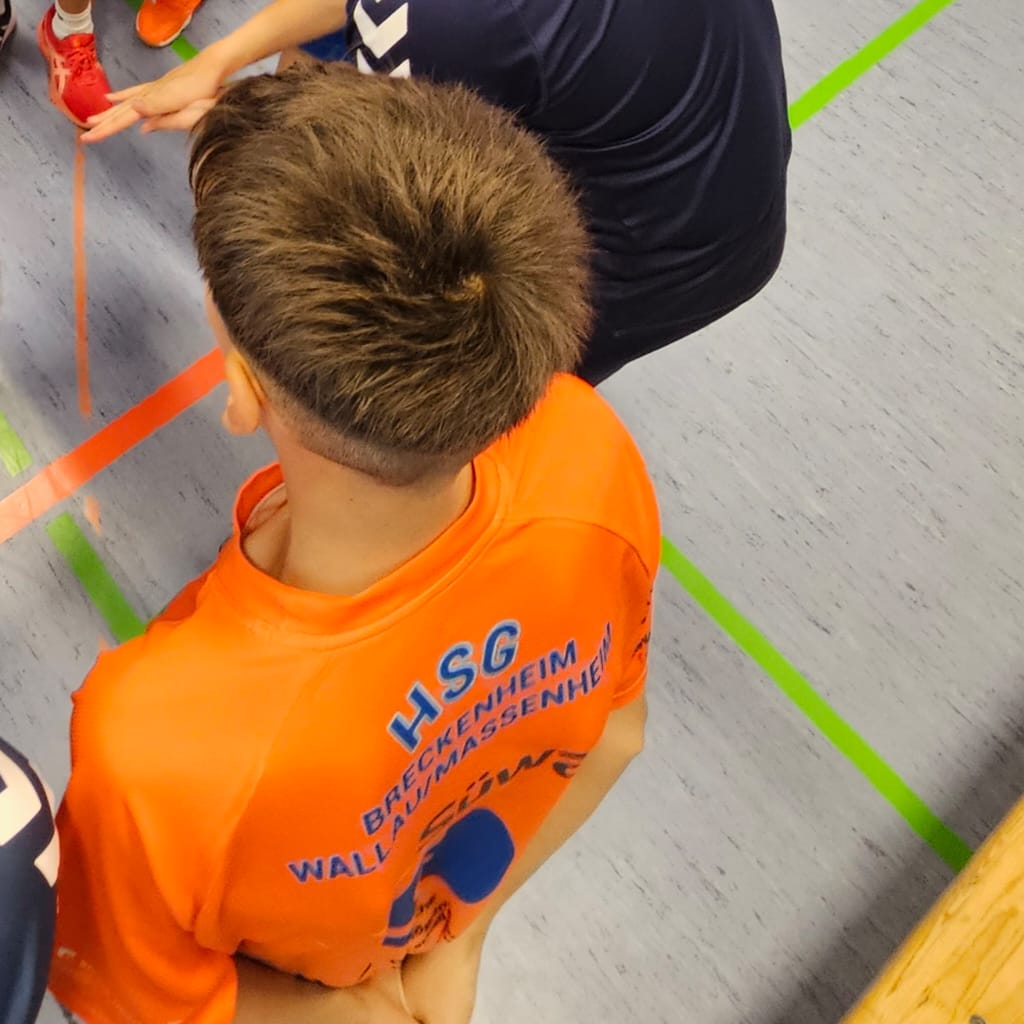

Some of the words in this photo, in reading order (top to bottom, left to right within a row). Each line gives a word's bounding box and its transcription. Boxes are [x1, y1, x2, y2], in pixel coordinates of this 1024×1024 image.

[288, 621, 613, 883] WALLAU/MASSENHEIM
[360, 639, 577, 838] BRECKENHEIM
[386, 618, 522, 754] HSG
